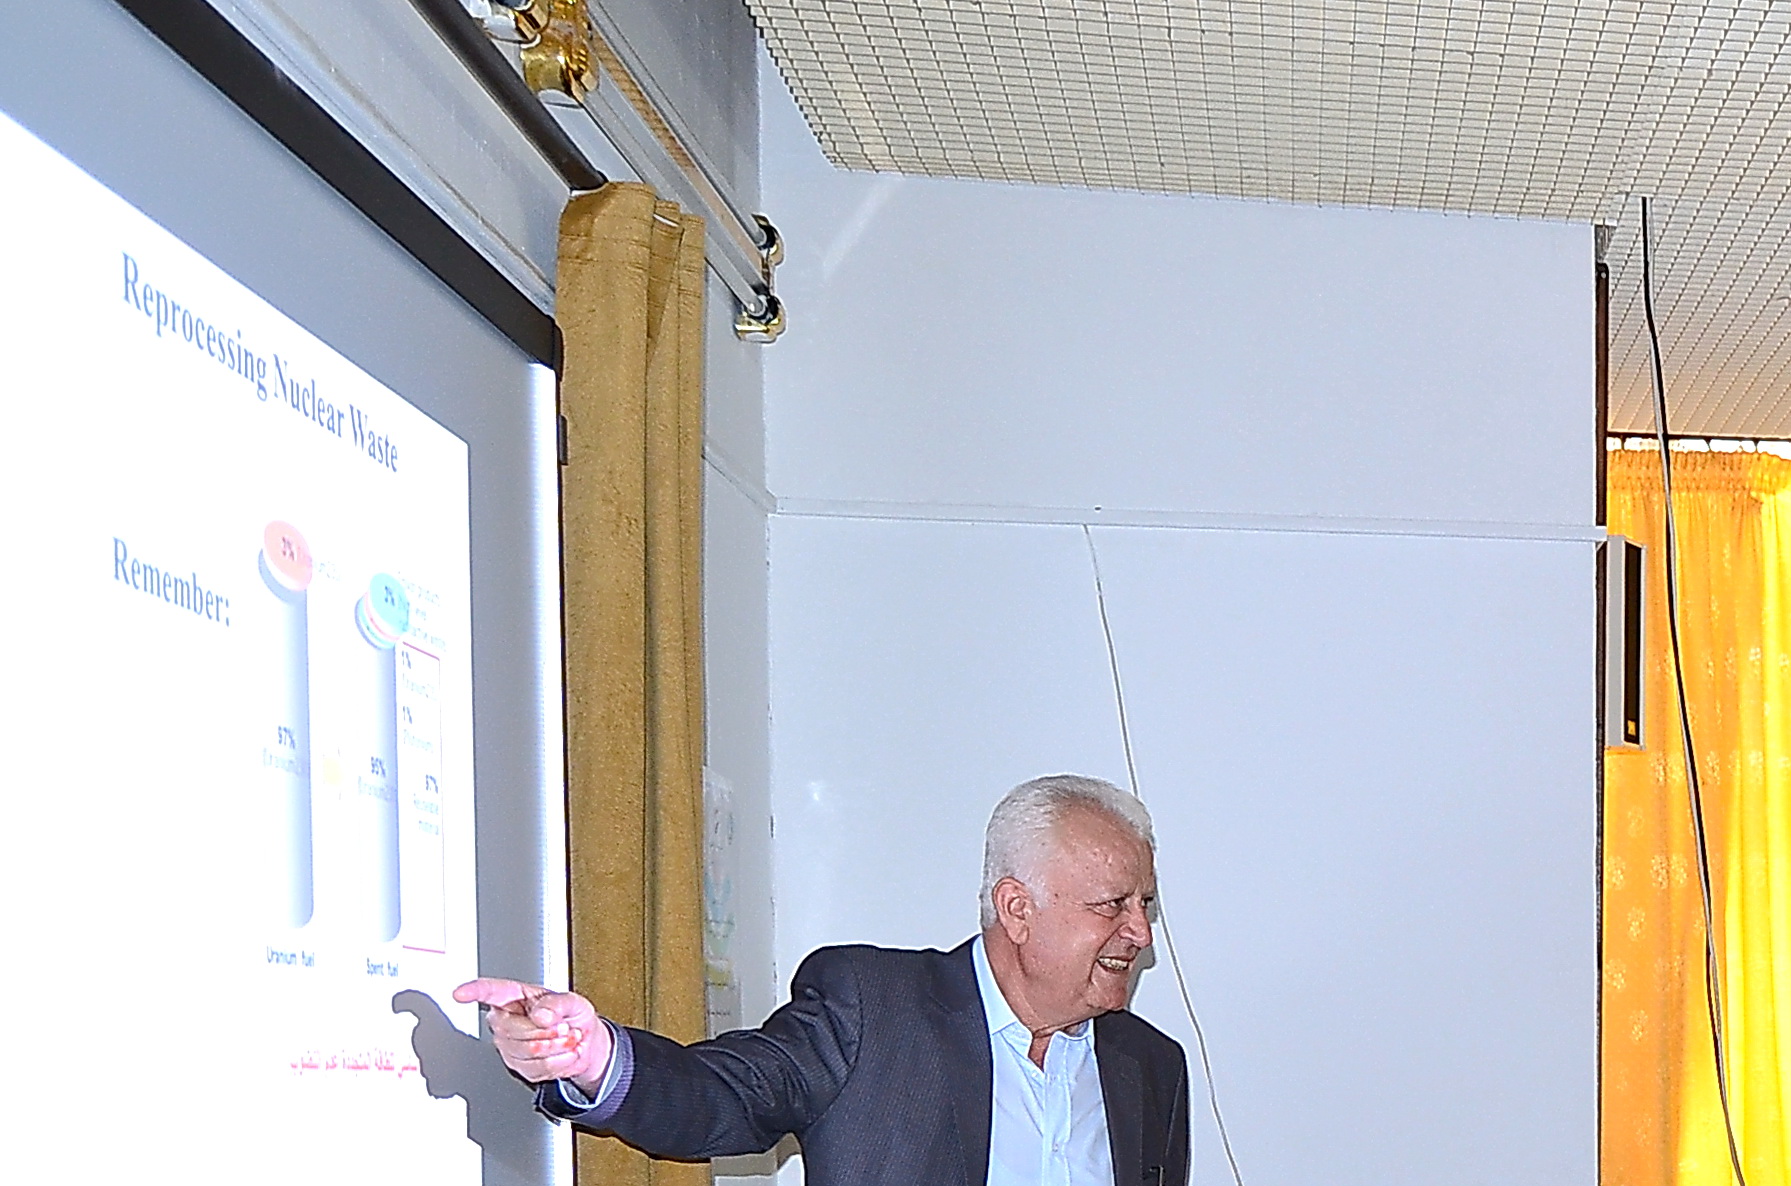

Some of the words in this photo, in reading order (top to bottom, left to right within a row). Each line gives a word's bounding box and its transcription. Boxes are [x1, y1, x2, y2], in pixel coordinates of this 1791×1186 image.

[122, 251, 267, 402] Reprocessing
[273, 353, 345, 438] Nuclear
[350, 404, 398, 473] Waste
[112, 537, 230, 627] Remember:
